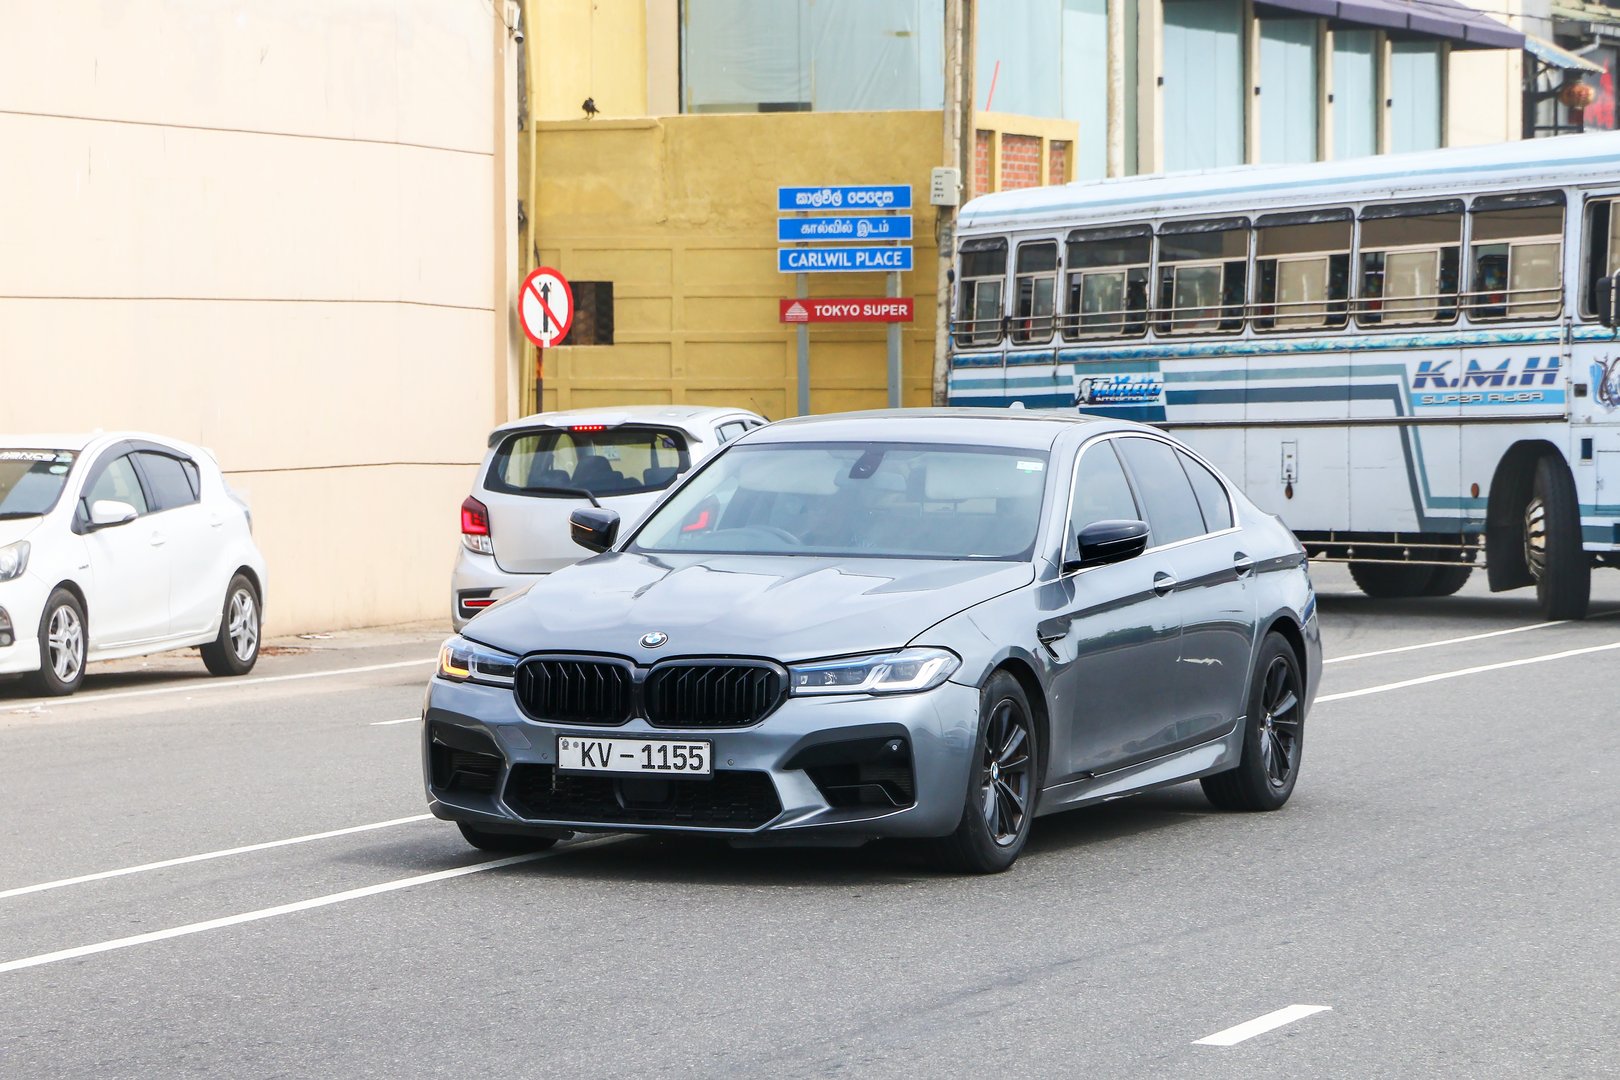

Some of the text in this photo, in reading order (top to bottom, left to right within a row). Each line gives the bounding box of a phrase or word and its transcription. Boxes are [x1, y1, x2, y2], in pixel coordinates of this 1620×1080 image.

[847, 190, 894, 207] පෙදෙස
[801, 218, 889, 237] கால்வில் இடம்
[788, 251, 902, 268] CARLWIL PLACE
[814, 304, 908, 317] TOKYO SUPER
[1412, 356, 1560, 389] K.M.H
